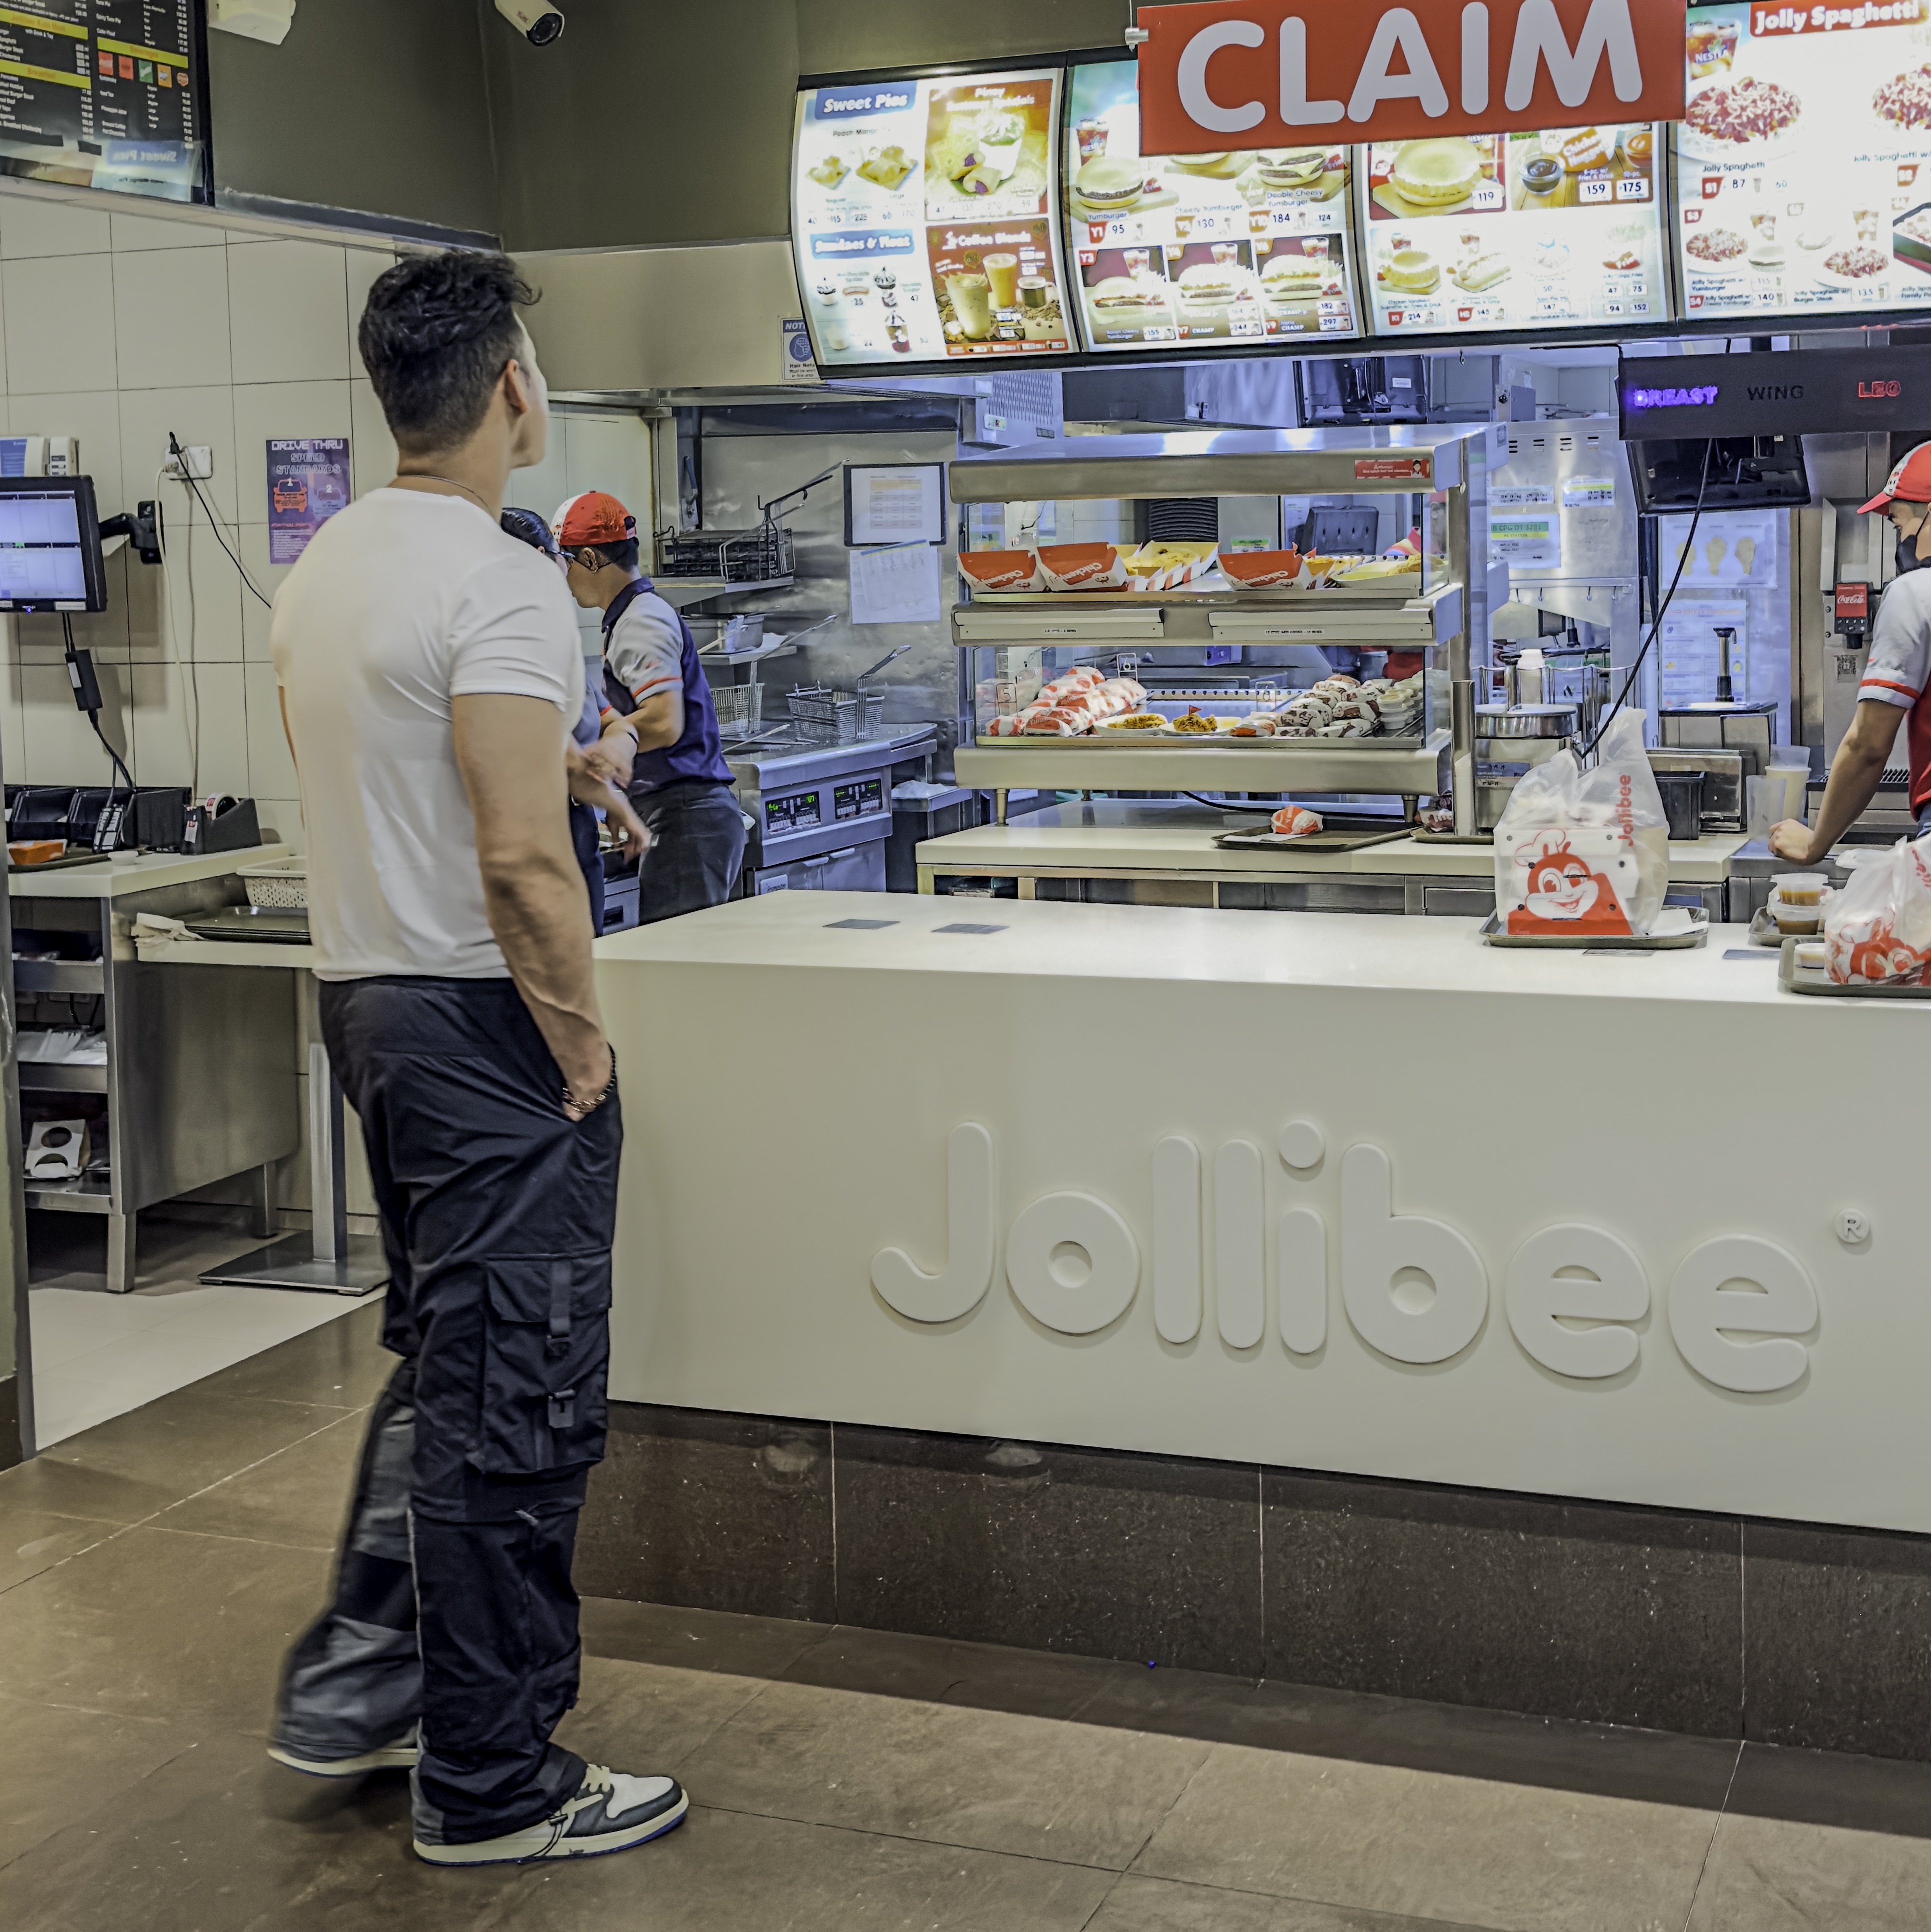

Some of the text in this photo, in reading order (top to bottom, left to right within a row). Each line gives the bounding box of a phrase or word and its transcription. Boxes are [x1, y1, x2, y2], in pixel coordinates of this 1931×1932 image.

[1755, 1, 1919, 35] Jolly Spaghetti
[1177, 0, 1643, 133] CLAIM
[823, 93, 908, 113] Sweet Pies
[1702, 161, 1765, 173] Jolly Spaghetti
[1586, 184, 1606, 195] 159
[1623, 182, 1642, 193] 175
[1732, 179, 1746, 189] 87
[1296, 190, 1324, 198] Cheesy
[1478, 192, 1494, 202] 119
[1273, 214, 1290, 223] 184
[1112, 224, 1125, 234] 95
[1634, 386, 1718, 407] BREAST
[1748, 385, 1804, 400] WING
[272, 439, 344, 451] DRIVE THRU
[290, 452, 325, 463] SPEED
[276, 463, 341, 475] STANDARDS
[287, 477, 293, 487] 1
[326, 484, 332, 494] 2
[1123, 657, 1131, 671] 6
[1003, 688, 1012, 702] 5
[1614, 774, 1634, 847] Jollibee
[870, 1119, 1819, 1394] Jollibee
